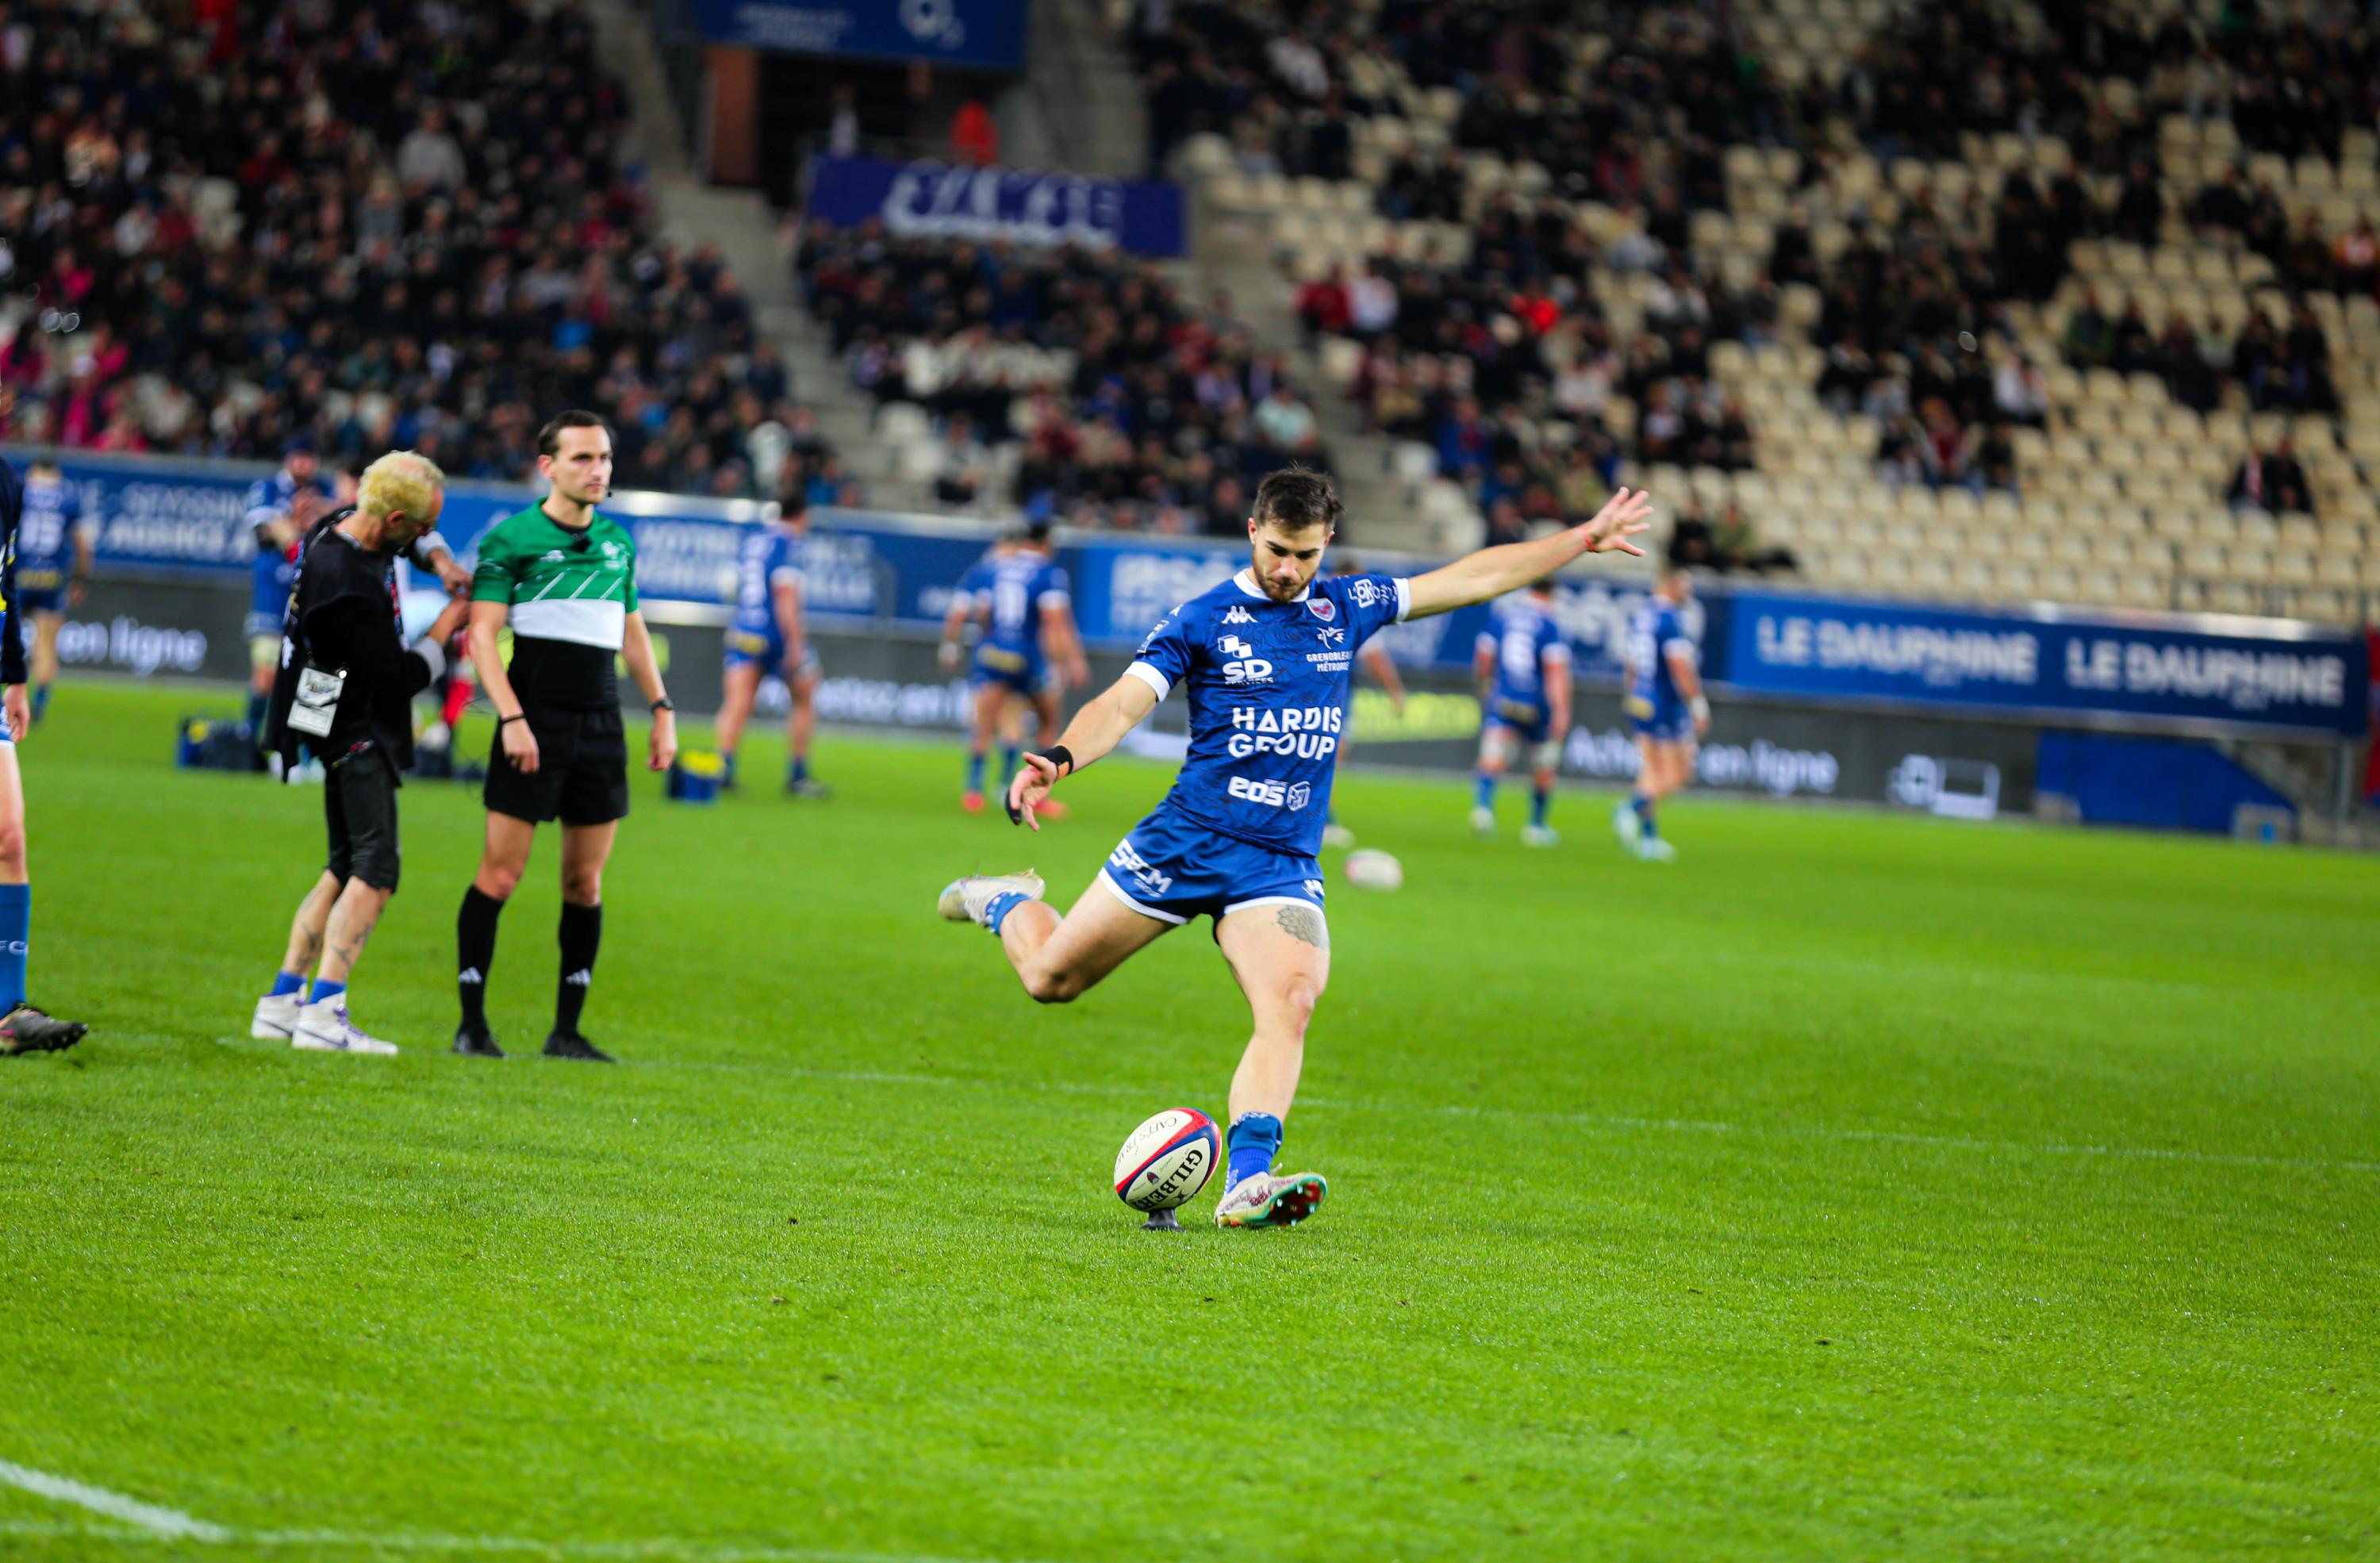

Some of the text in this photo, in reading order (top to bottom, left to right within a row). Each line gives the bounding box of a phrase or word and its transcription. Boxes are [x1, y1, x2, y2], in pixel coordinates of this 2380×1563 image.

[1756, 616, 1812, 666] LE
[1223, 659, 1273, 681] SD
[2066, 637, 2120, 689] LE
[1232, 706, 1342, 733] HARDIS
[1228, 732, 1335, 761] GROUP
